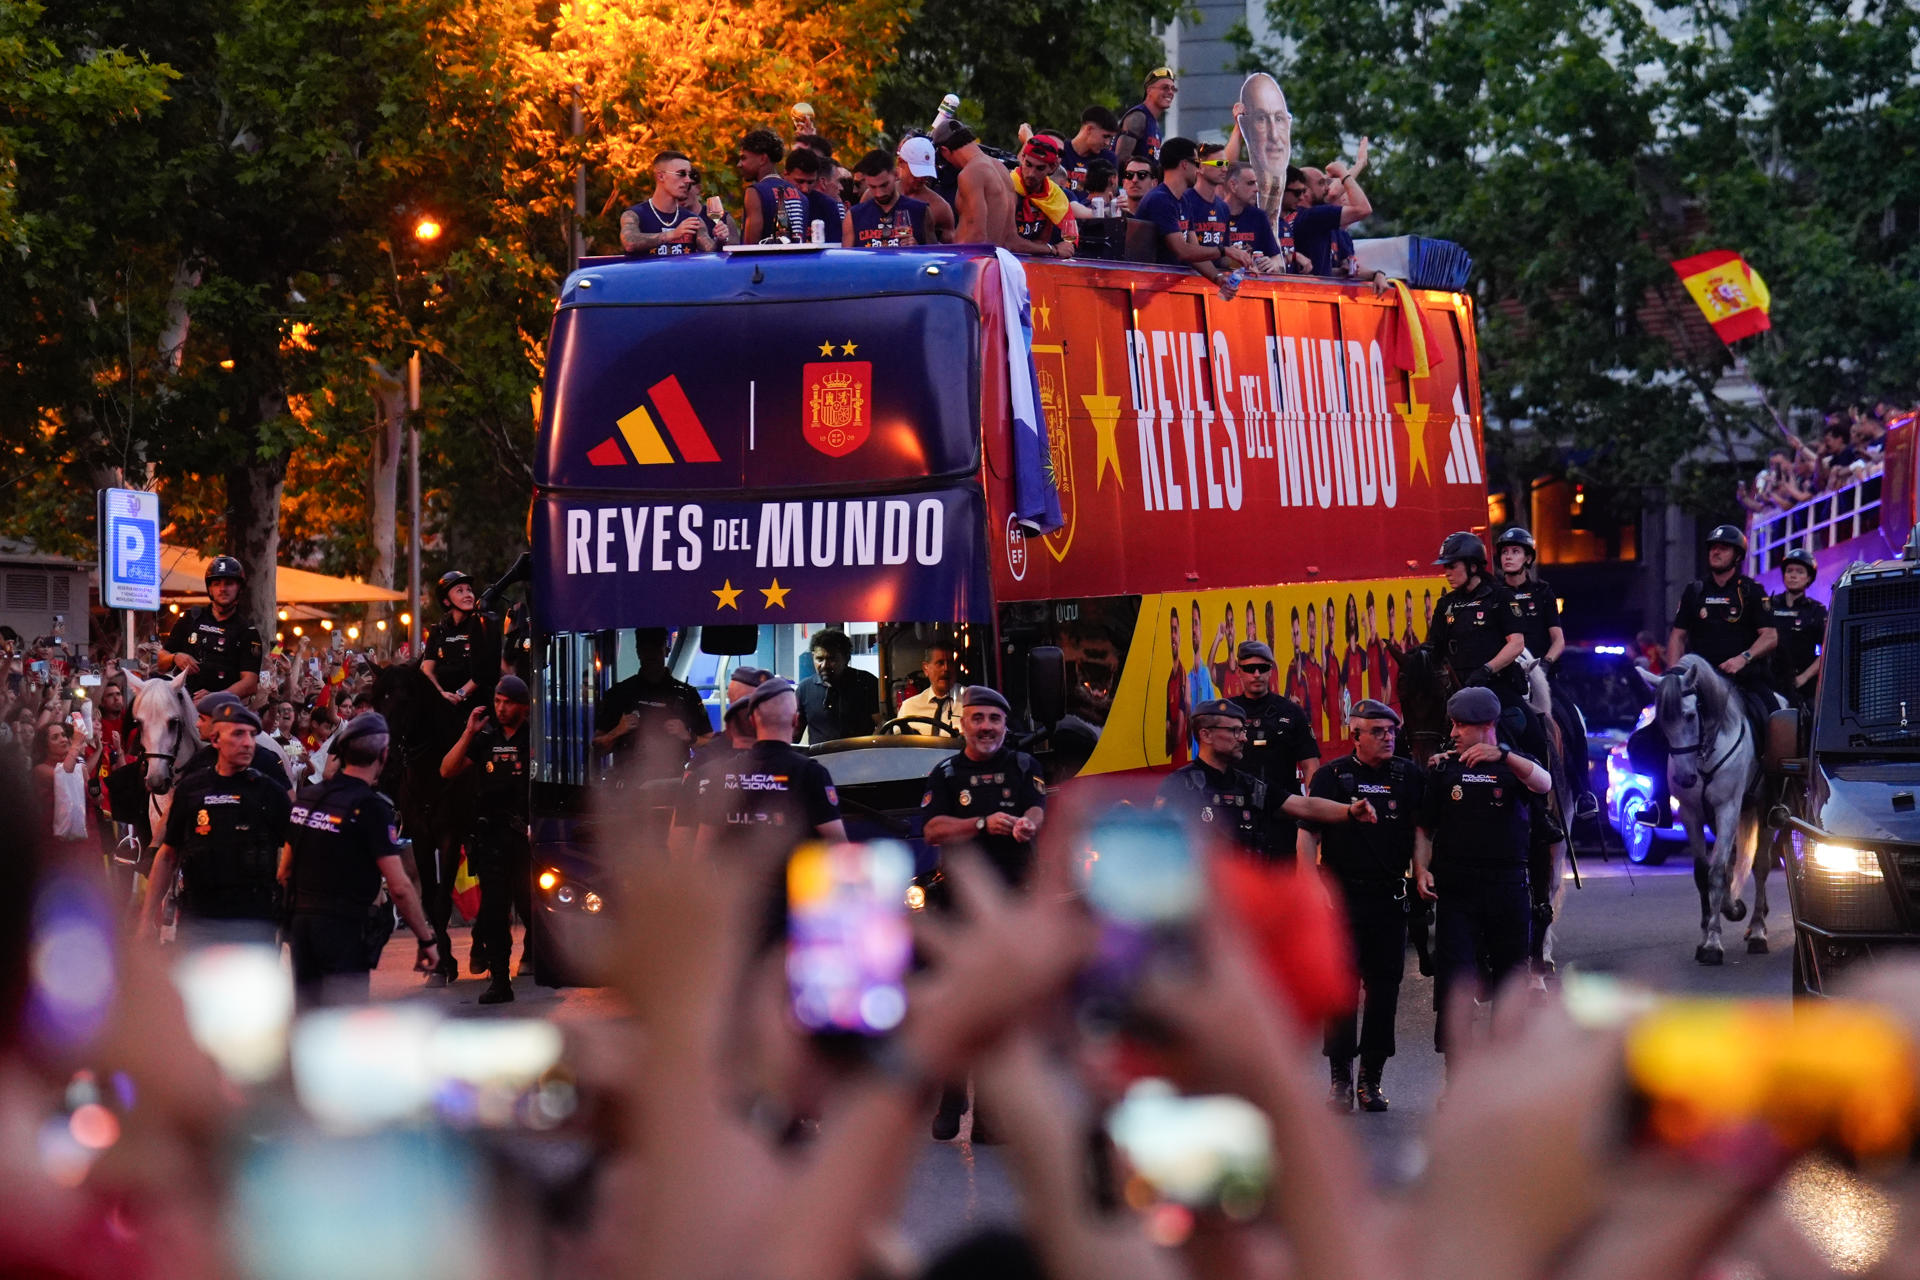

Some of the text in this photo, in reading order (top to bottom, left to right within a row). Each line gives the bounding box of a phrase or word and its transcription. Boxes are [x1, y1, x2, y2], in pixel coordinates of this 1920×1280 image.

[1126, 329, 1397, 511] REYES DEL MUNDO
[117, 523, 145, 578] P
[566, 498, 945, 575] REYES DEL MUNDO
[1010, 530, 1021, 544] RF
[1011, 549, 1023, 564] EF
